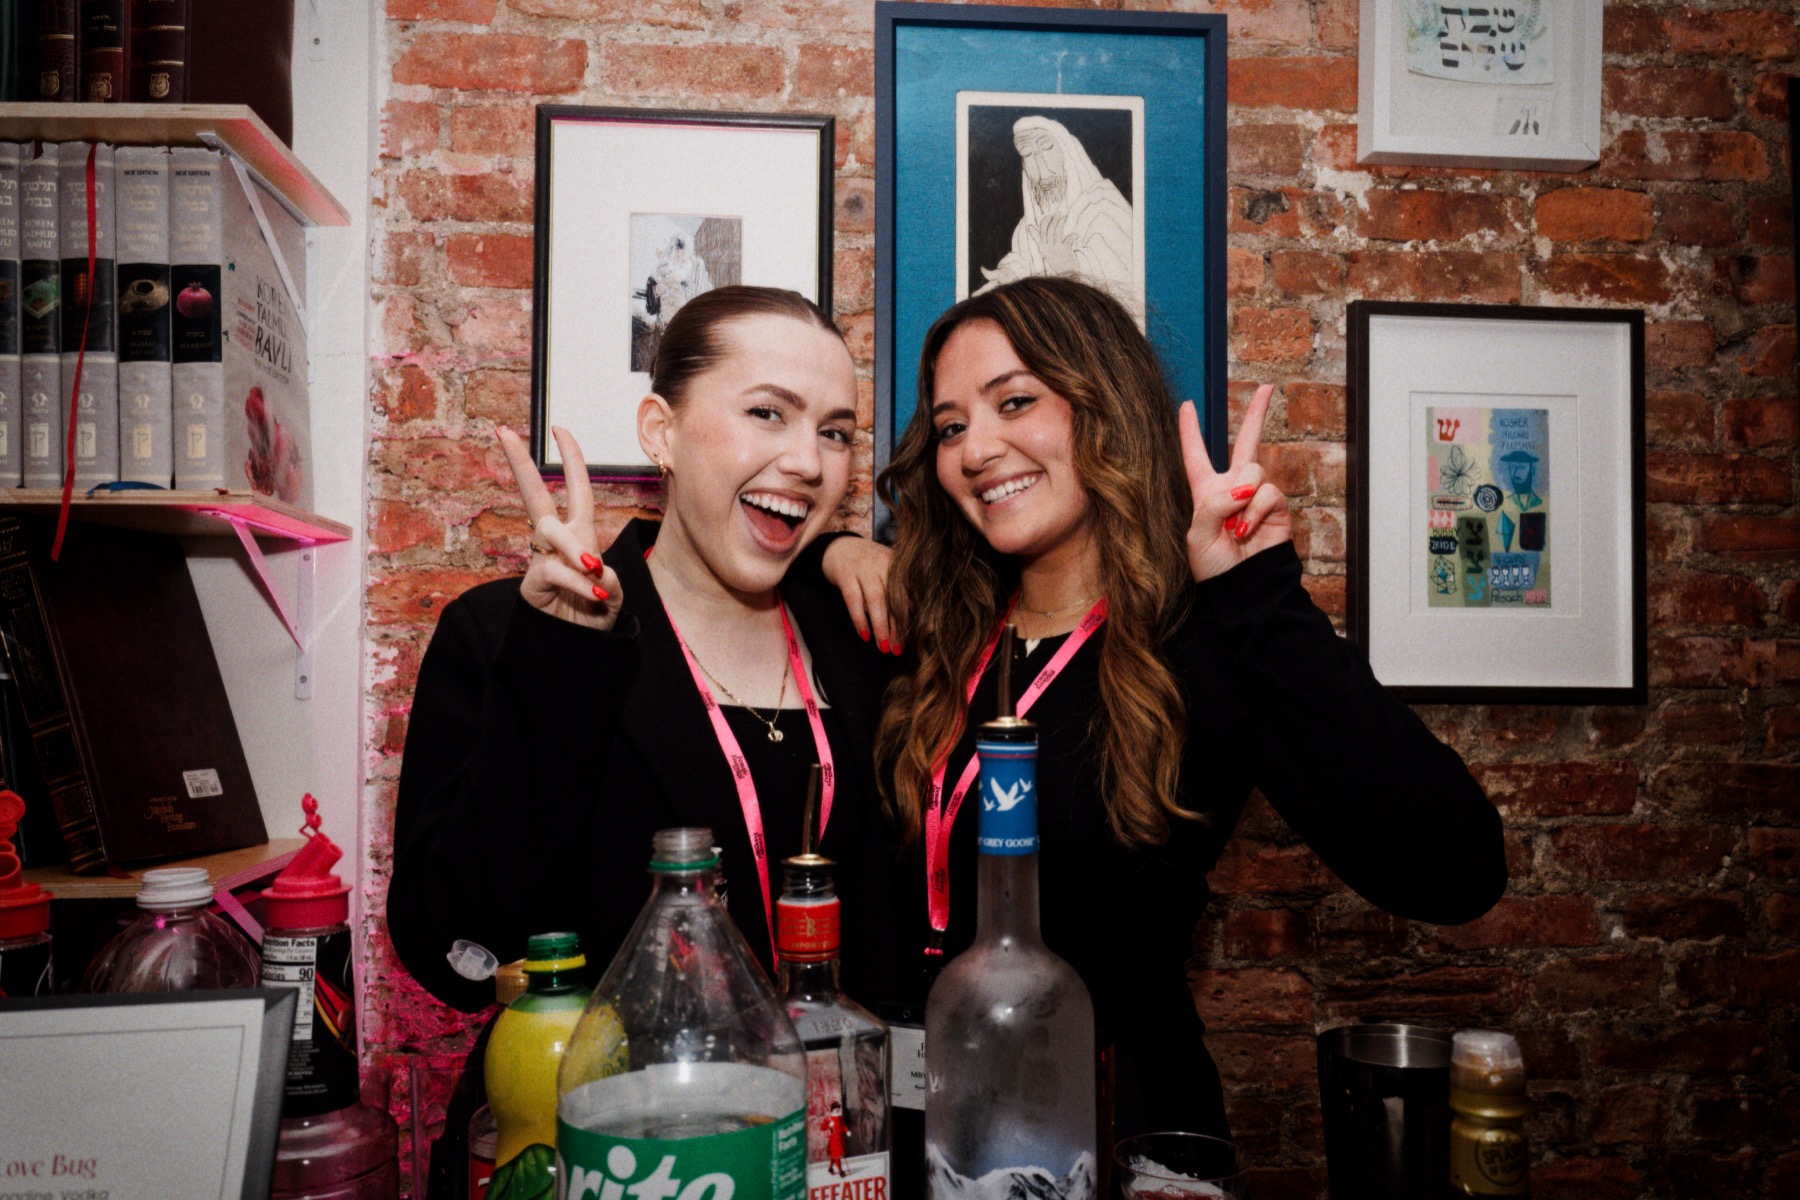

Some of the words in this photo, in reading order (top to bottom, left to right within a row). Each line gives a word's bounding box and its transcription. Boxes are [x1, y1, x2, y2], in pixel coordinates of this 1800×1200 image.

[257, 301, 290, 341] TALMU
[255, 325, 293, 374] BAVLI
[1437, 418, 1460, 442] ש
[1499, 417, 1529, 428] KOSHER
[1503, 553, 1527, 564] CUPS
[1490, 588, 1523, 603] Pesach
[982, 837, 1004, 848] GREY
[291, 937, 316, 947] Facts
[299, 967, 314, 980] 90
[0, 1157, 44, 1177] ove
[51, 1153, 97, 1180] Bug
[568, 1144, 736, 1200] rite
[808, 1176, 887, 1200] EFEATER
